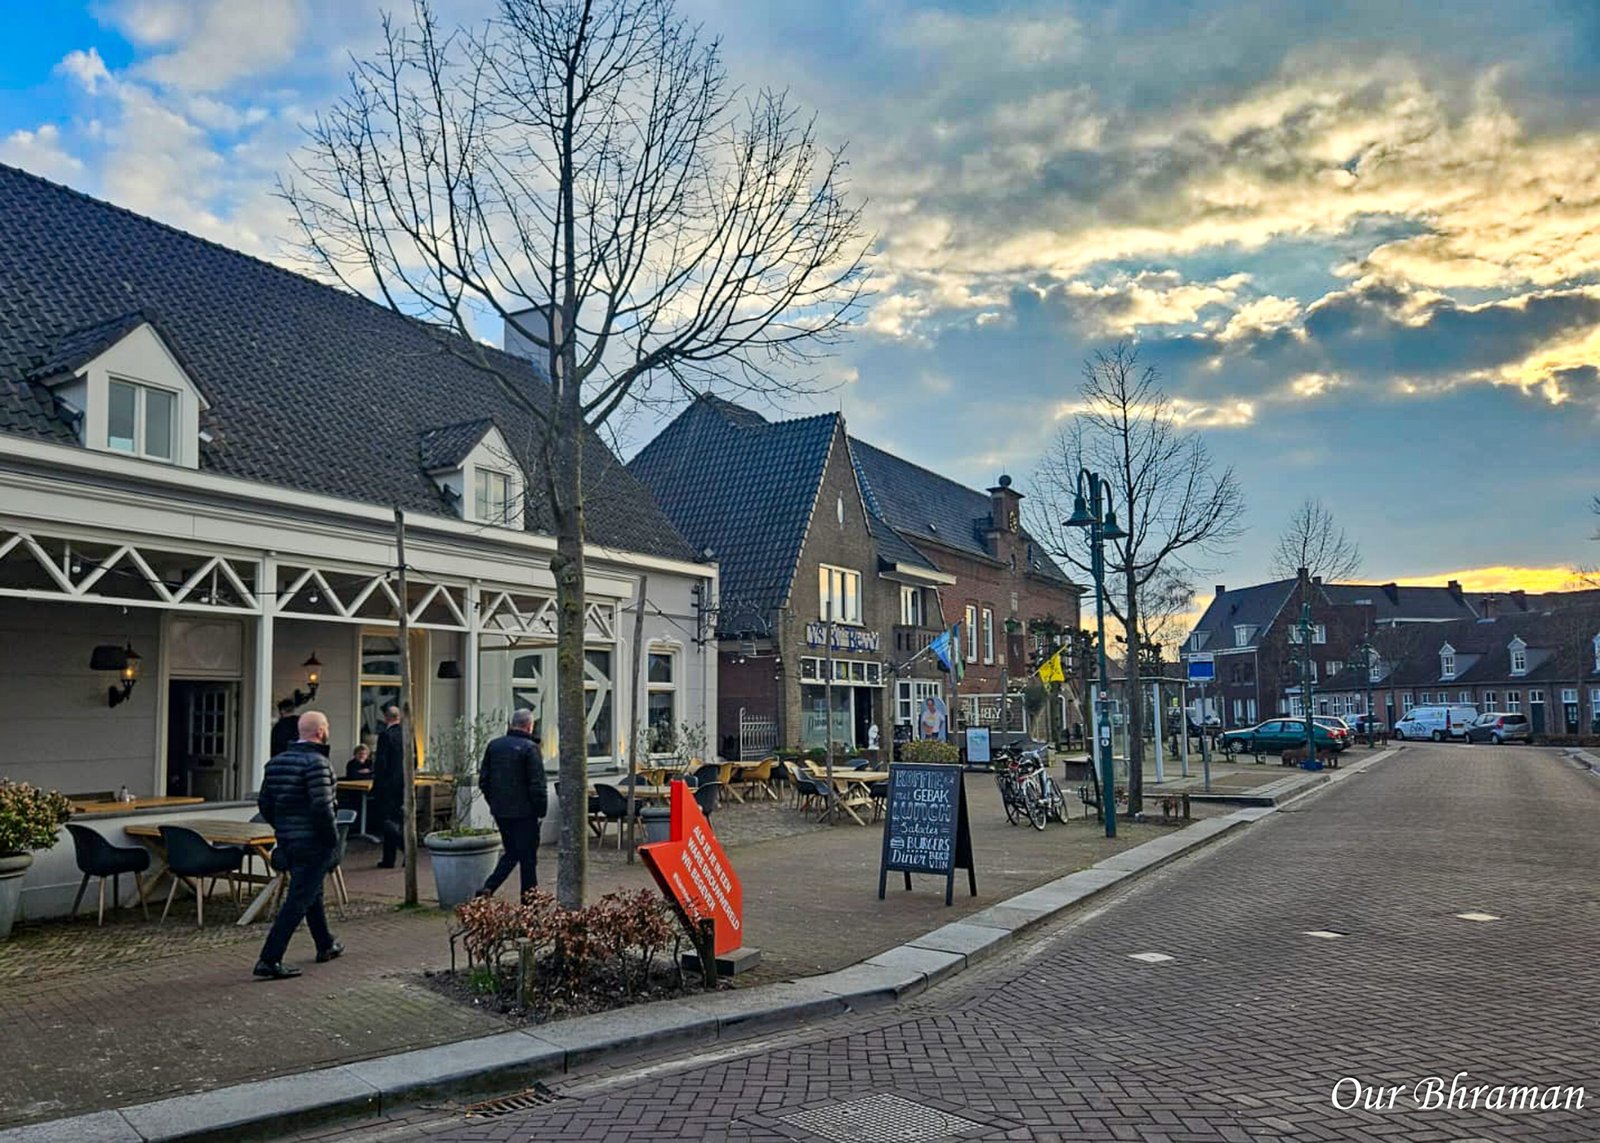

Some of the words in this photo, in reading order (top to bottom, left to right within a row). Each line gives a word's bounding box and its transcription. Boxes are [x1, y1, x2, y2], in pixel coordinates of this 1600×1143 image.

[913, 788, 949, 802] GEBAK
[688, 837, 704, 868] WARE
[907, 836, 950, 851] BURGERS
[693, 826, 705, 845] ALS
[714, 862, 722, 876] IN
[720, 872, 732, 894] EEN
[892, 849, 926, 865] Diner
[682, 850, 693, 872] WIL
[691, 868, 715, 911] BEGEVEN
